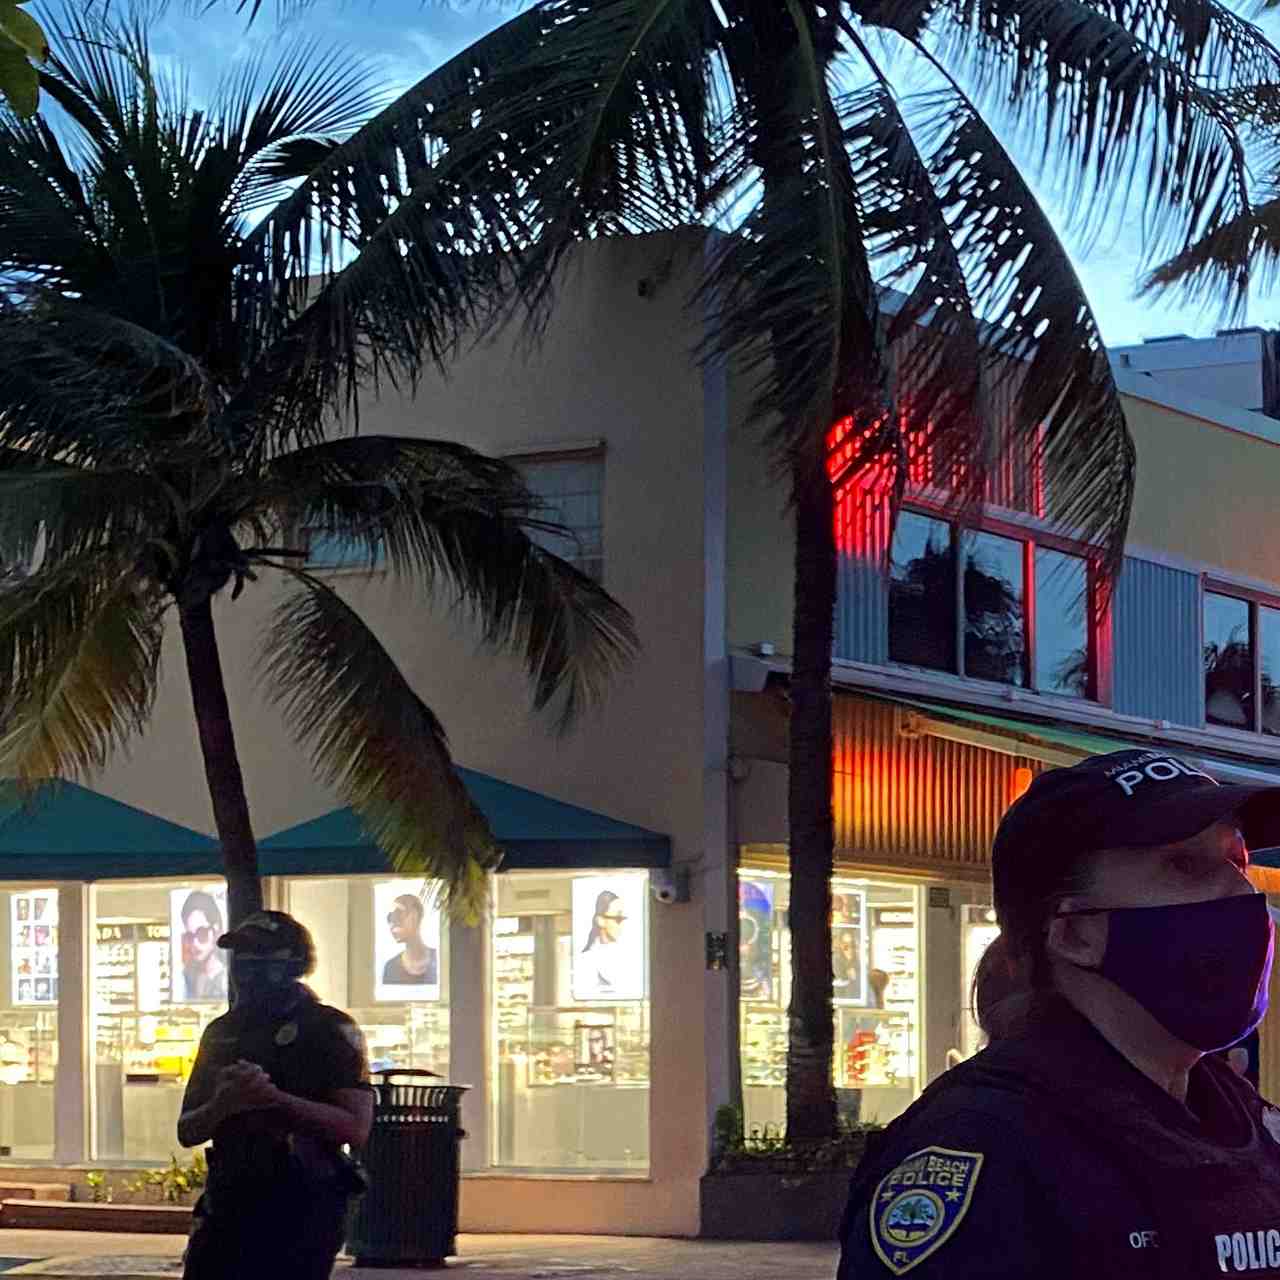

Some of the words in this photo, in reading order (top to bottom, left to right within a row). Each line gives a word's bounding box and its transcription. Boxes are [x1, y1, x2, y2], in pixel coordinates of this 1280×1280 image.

[1115, 758, 1203, 795] POL
[927, 1155, 970, 1174] BEACH
[889, 1171, 967, 1187] POLICE
